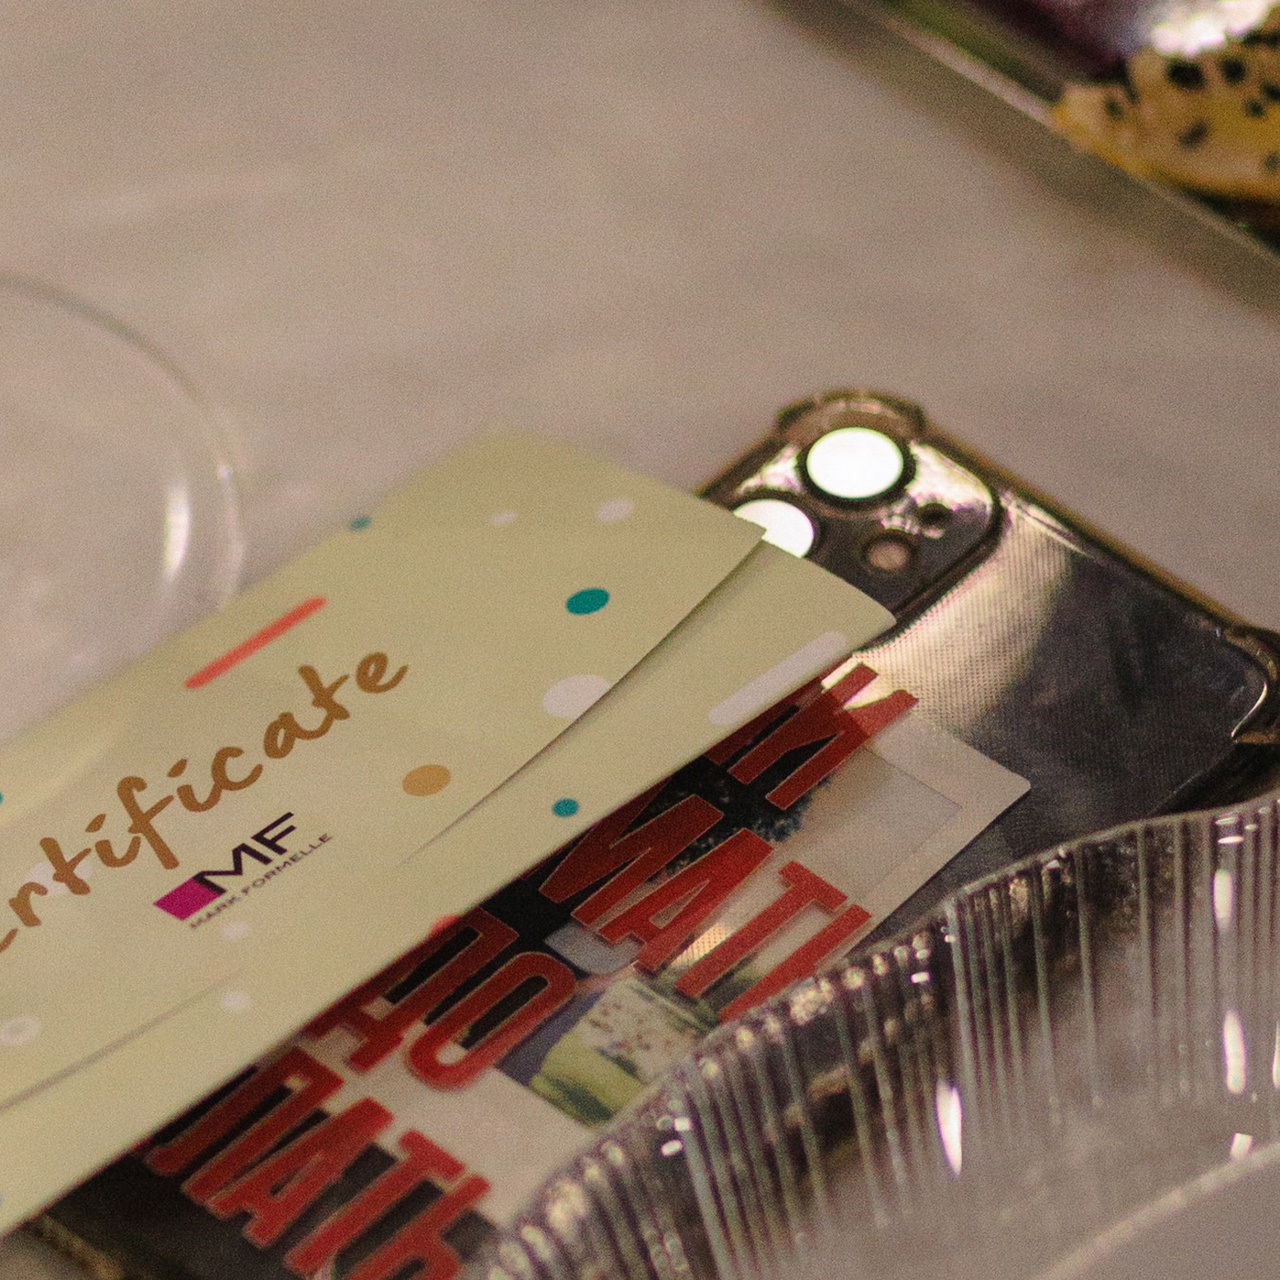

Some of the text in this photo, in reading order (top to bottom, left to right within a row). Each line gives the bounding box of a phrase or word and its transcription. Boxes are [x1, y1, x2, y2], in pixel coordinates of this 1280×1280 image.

[189, 832, 333, 930] MARK FORMELLE
[192, 811, 297, 894] MF
[303, 907, 576, 1091] ДО
